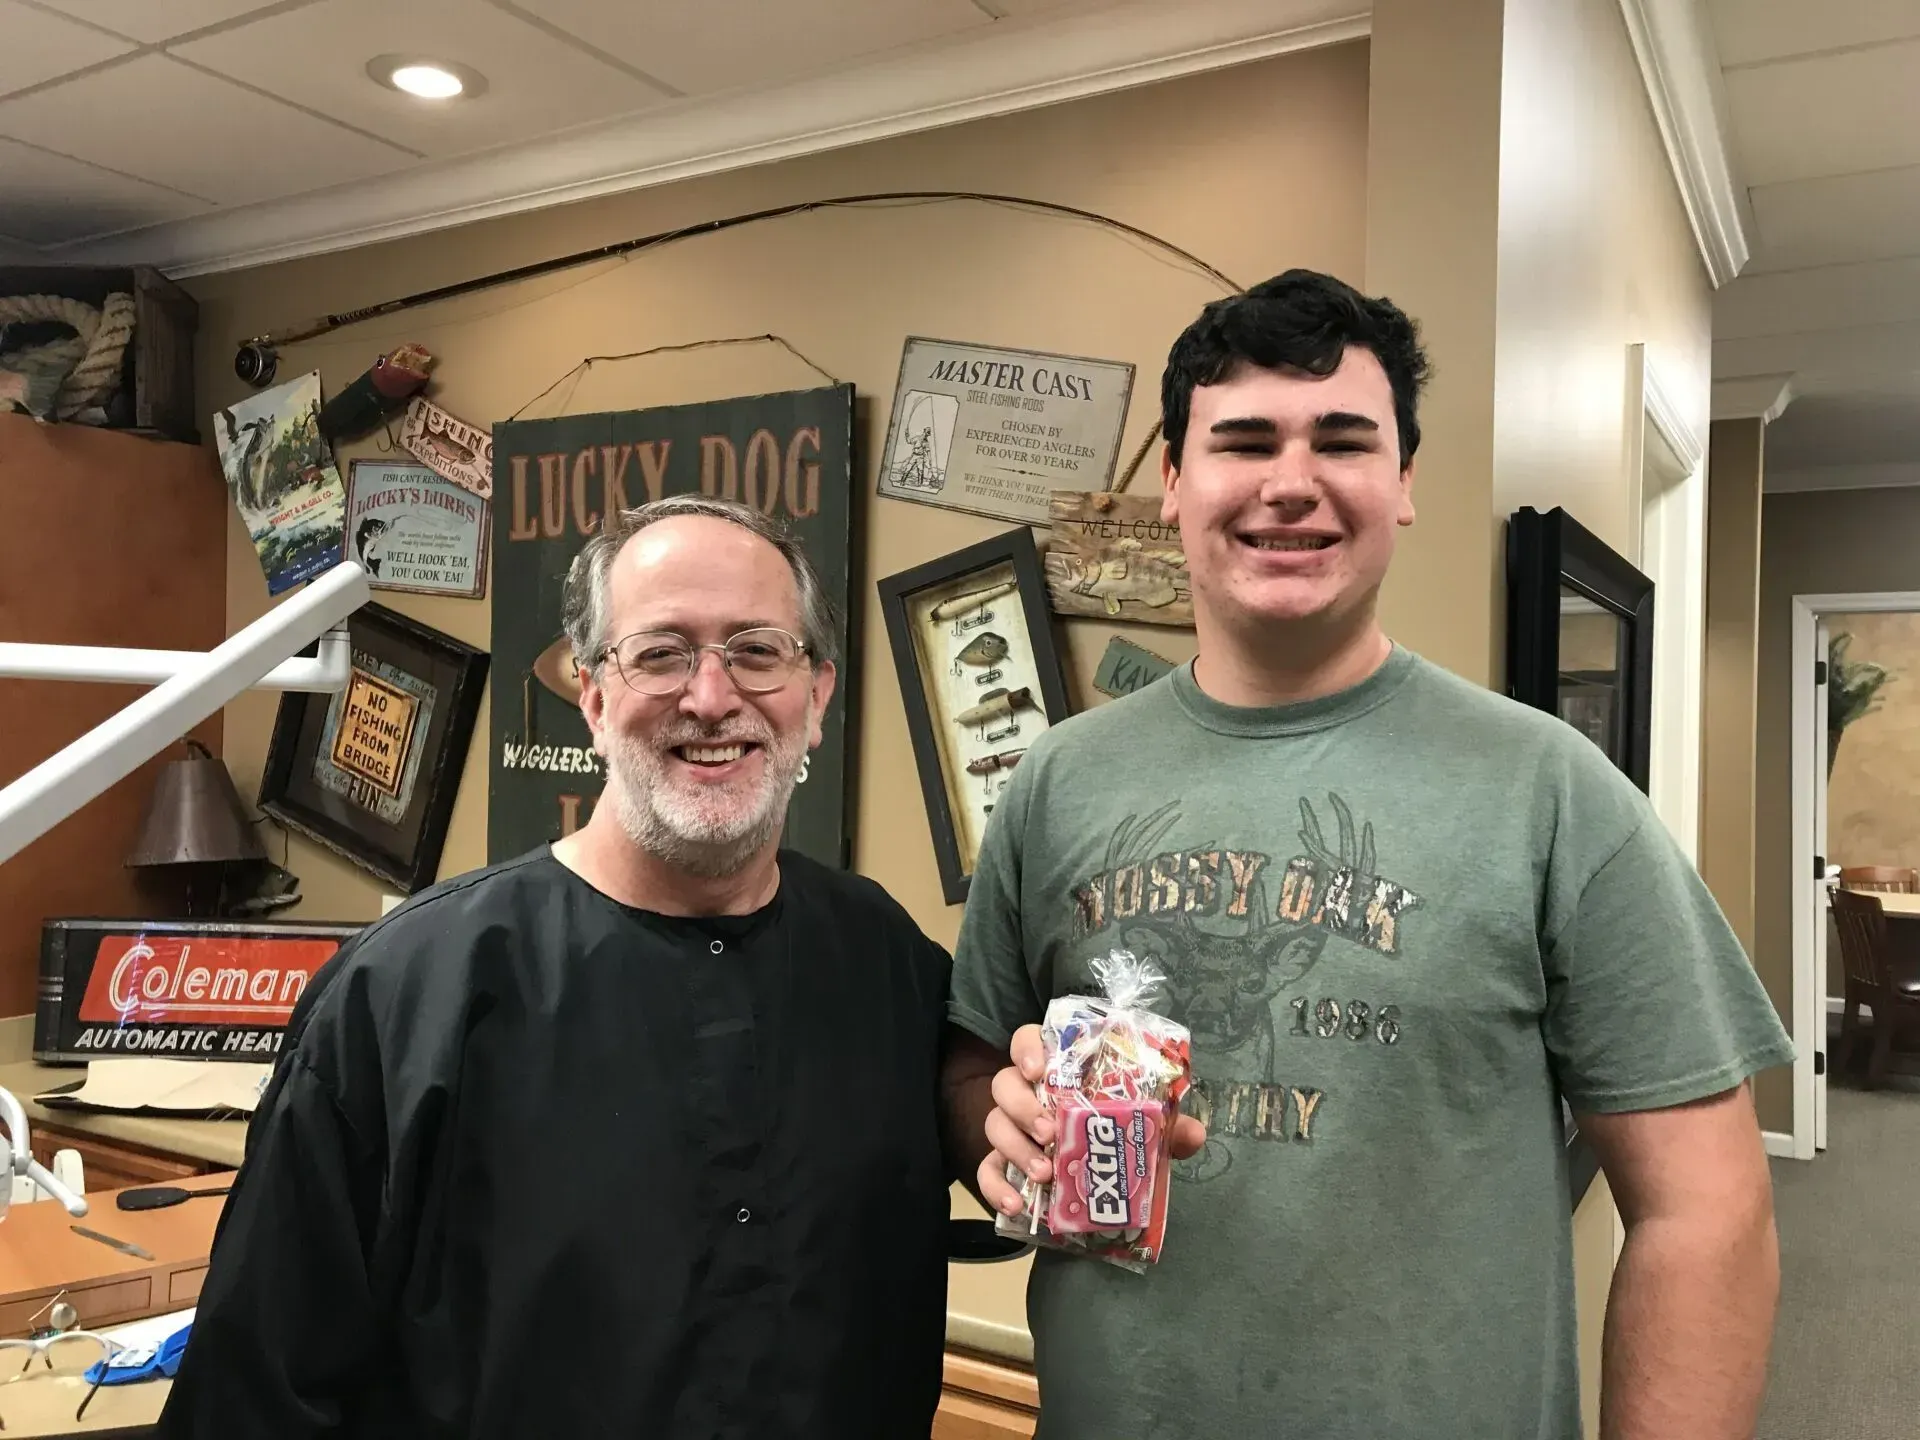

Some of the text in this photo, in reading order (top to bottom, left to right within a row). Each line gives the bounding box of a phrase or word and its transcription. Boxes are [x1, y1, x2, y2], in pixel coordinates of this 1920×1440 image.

[927, 360, 1093, 401] MASTER CAST
[966, 390, 1045, 413] STEEL FISHING RODS
[966, 428, 1096, 459] EXPERIENCED ANGLERS
[1001, 419, 1063, 439] CHOSEN BY
[414, 442, 474, 485] EXPEDITIONS
[976, 444, 1079, 471] FOR OVER 50 YEARS
[382, 474, 399, 482] FISH
[400, 474, 421, 483] CAN'T
[509, 426, 821, 541] LUCKY DOG
[965, 485, 987, 496] WITH
[978, 475, 1004, 488] THINK
[1005, 480, 1024, 490] YOU
[356, 486, 476, 524] LUCKY'S LURES
[1081, 517, 1181, 541] WELCOM
[387, 551, 470, 569] WE'LL HOOK 'EM,
[391, 567, 464, 583] YOU COOK 'EM!
[367, 691, 388, 712] NO
[349, 704, 402, 741] FISHING
[352, 727, 389, 757] FROM
[503, 742, 600, 775] WIGGLERS,
[344, 743, 391, 780] BRIDGE
[347, 775, 382, 813] FUN
[1073, 850, 1420, 953] MOSSY OAK
[109, 943, 309, 1012] Coleman
[1289, 996, 1400, 1045] 1986
[74, 1029, 213, 1051] AUTOMATIC
[1134, 1111, 1146, 1177] CLASSIC BUBBLE
[1087, 1116, 1128, 1224] Extra
[1116, 1127, 1128, 1196] LONG LASTING FLAVOR
